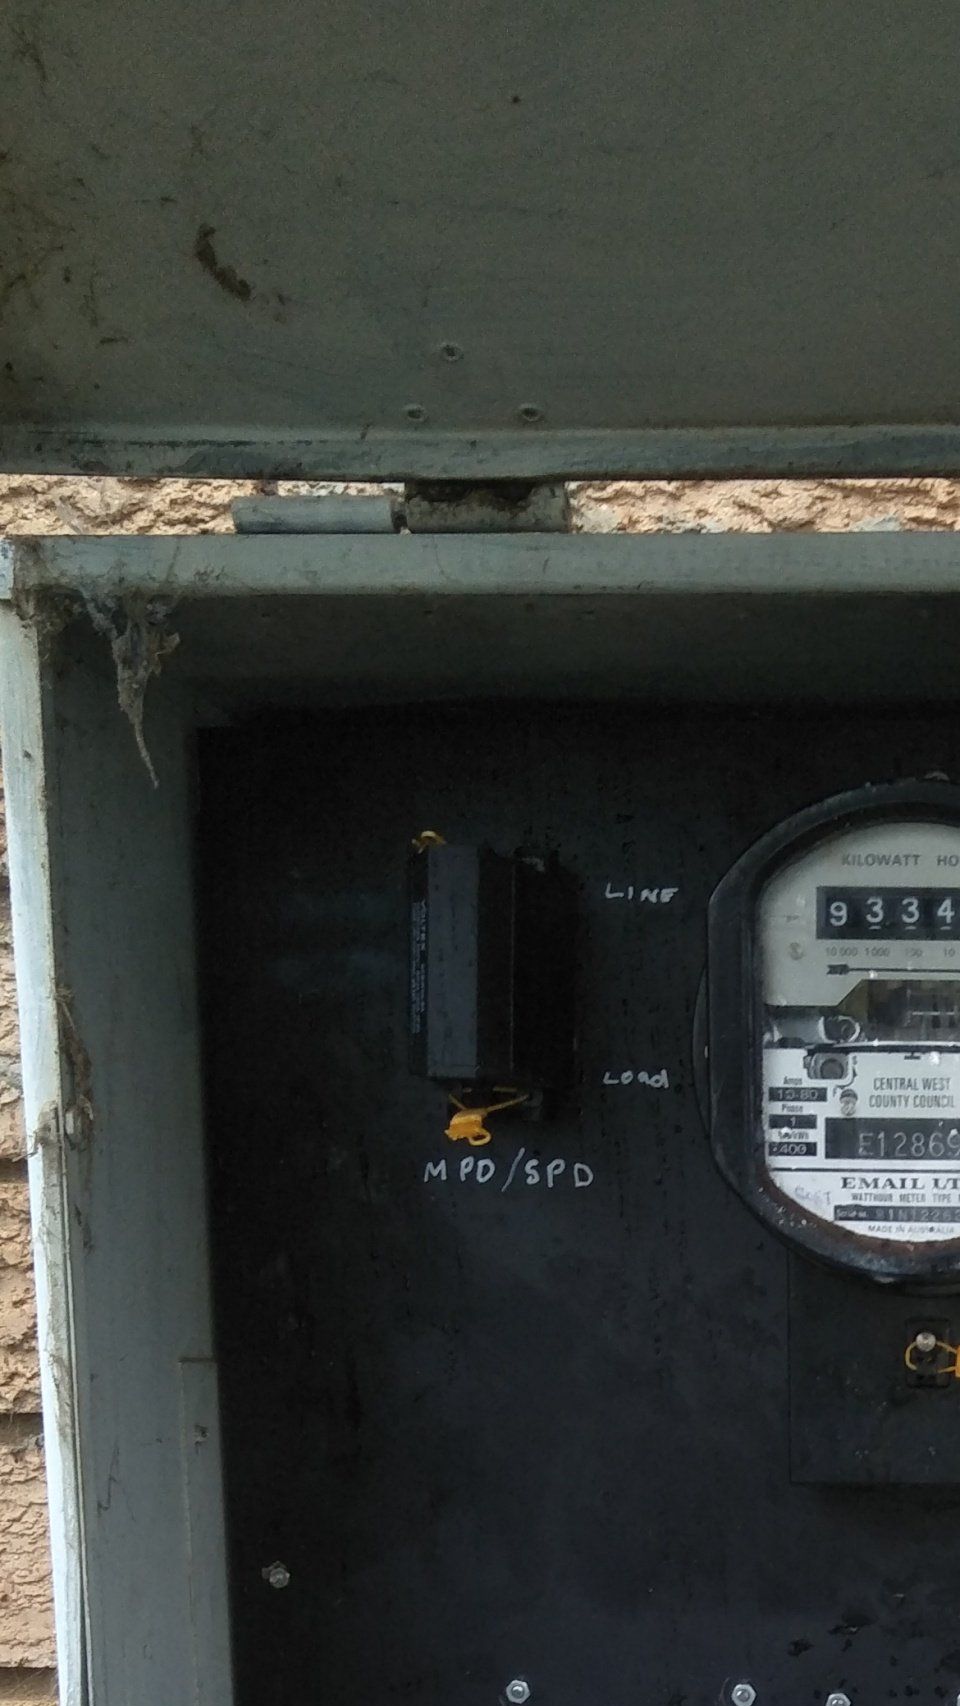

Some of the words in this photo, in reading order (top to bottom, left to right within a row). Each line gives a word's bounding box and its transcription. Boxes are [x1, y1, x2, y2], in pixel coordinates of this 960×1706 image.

[841, 853, 921, 867] KILOWATT
[605, 881, 679, 904] LINE
[873, 1078, 919, 1092] CENTRAL
[923, 1078, 951, 1092] WEST
[869, 1095, 910, 1108] COUNTY
[913, 1096, 955, 1109] COUNCIL
[841, 1176, 925, 1189] EMAIL
[899, 1193, 926, 1203] METER
[932, 1193, 951, 1203] TYPE
